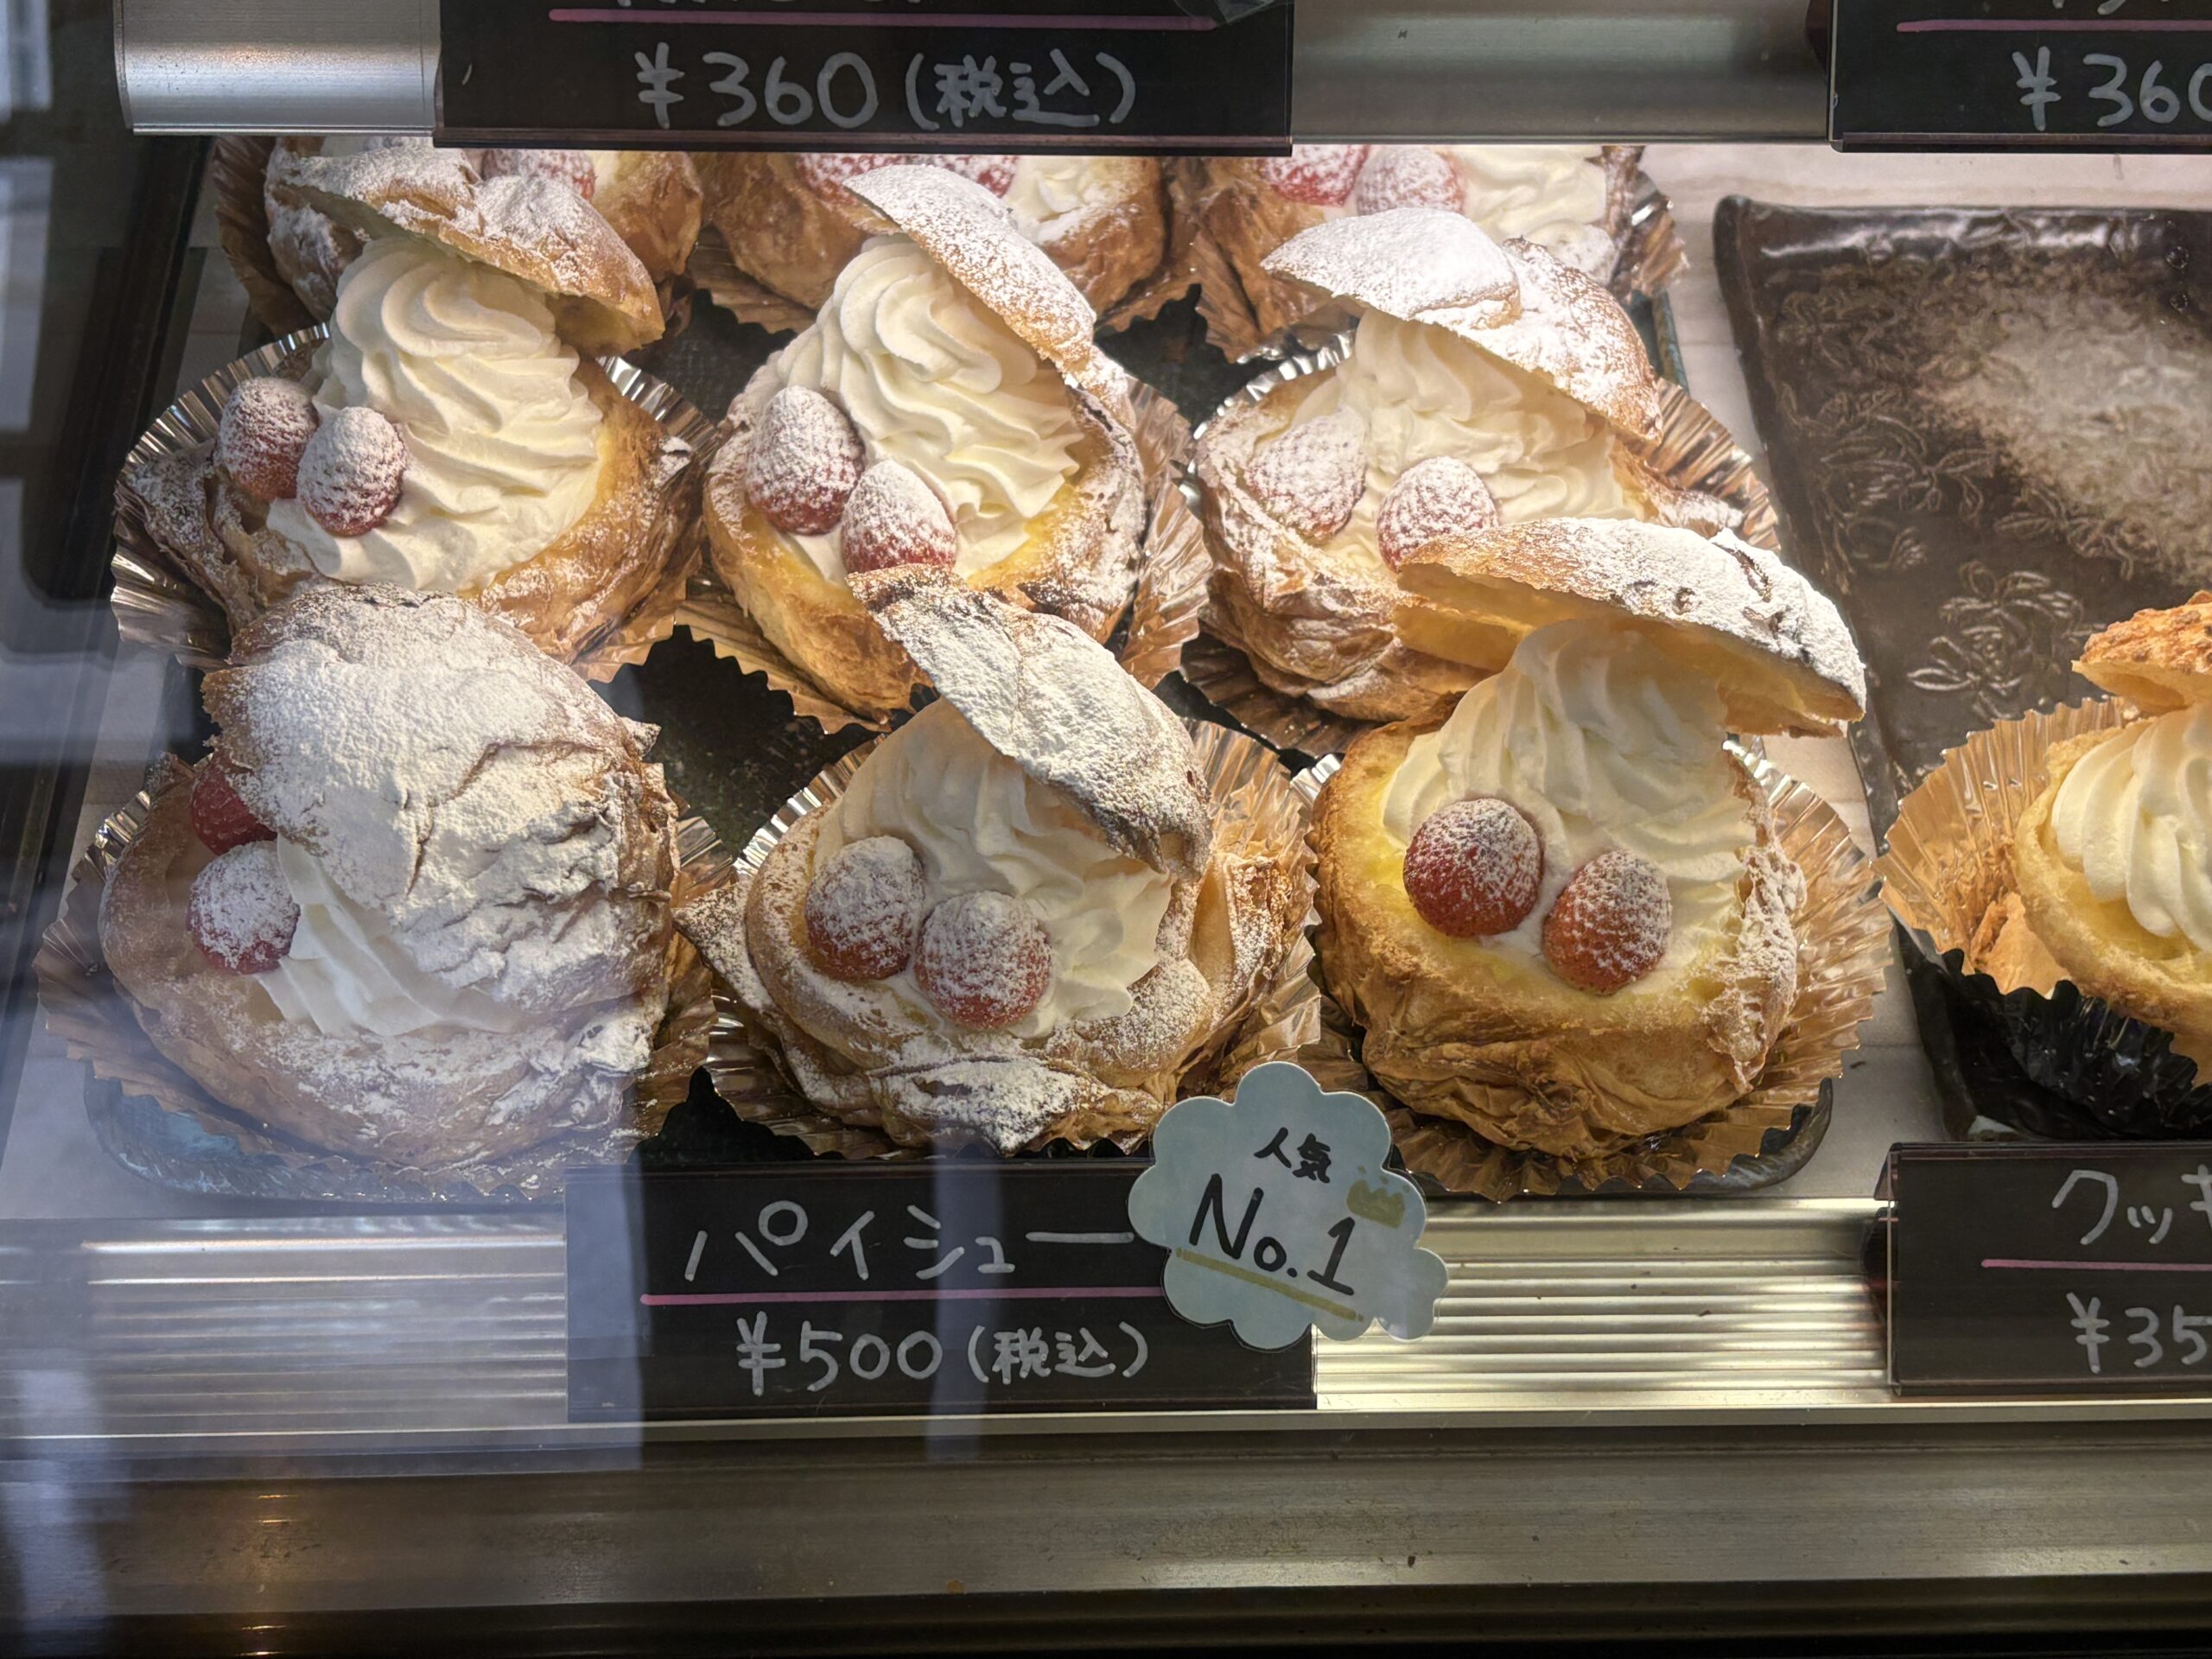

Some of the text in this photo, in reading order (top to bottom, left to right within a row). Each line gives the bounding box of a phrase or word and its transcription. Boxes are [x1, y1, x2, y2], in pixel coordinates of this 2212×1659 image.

[1253, 1127, 1332, 1184] 人気
[685, 1199, 1135, 1281] パイシュー
[2066, 1293, 2212, 1374] ¥35
